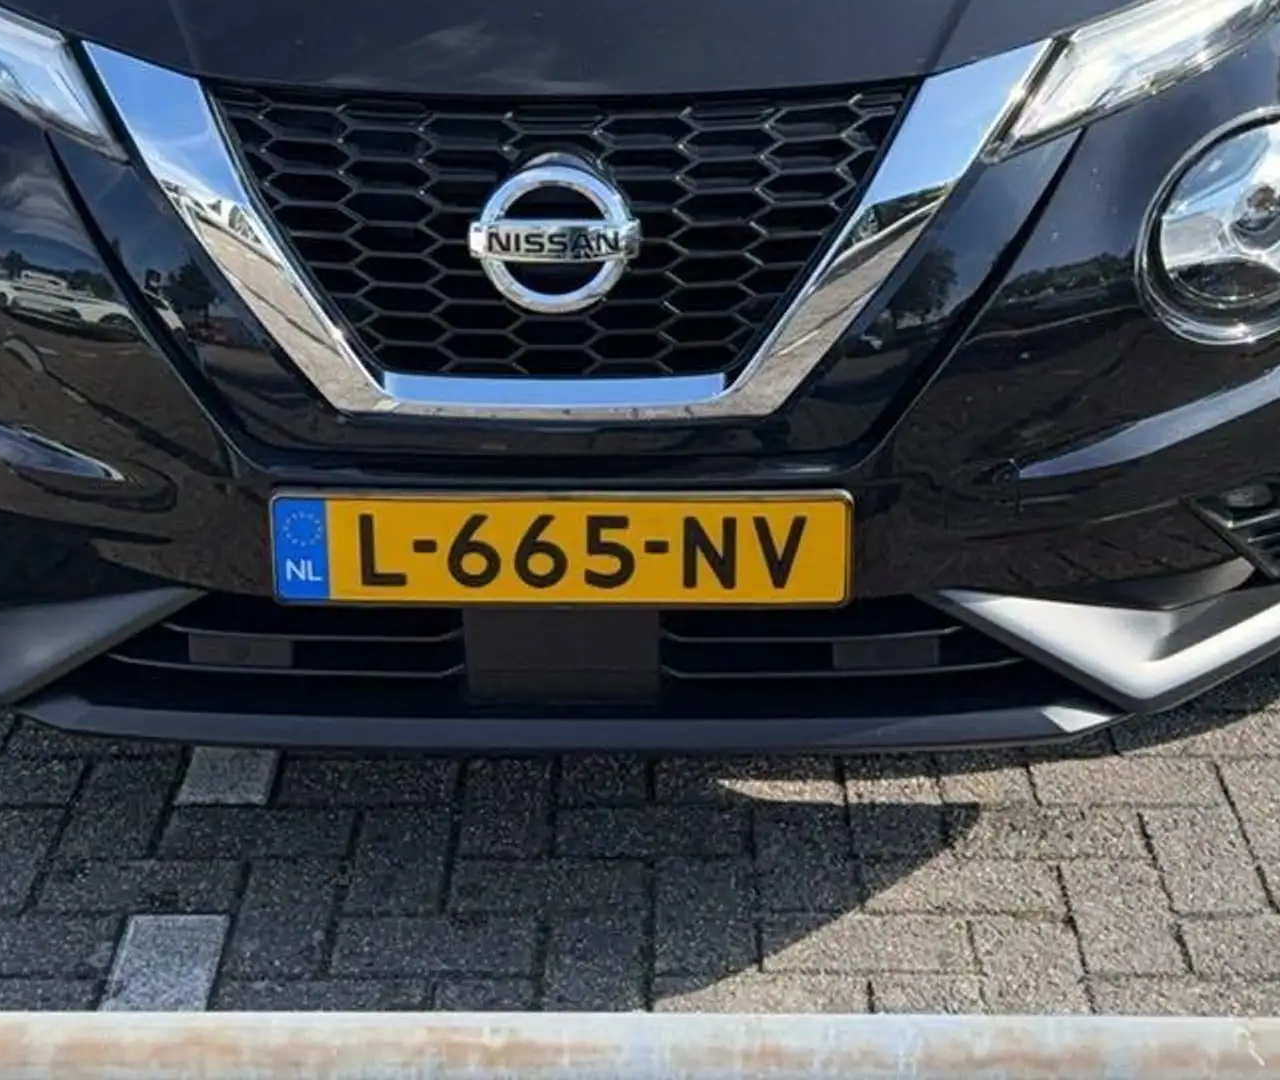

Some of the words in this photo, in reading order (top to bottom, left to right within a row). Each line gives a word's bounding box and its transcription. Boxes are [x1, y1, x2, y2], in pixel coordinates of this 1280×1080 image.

[487, 231, 620, 254] NISSAN
[285, 559, 321, 582] NL
[357, 514, 807, 589] L-665-NV
